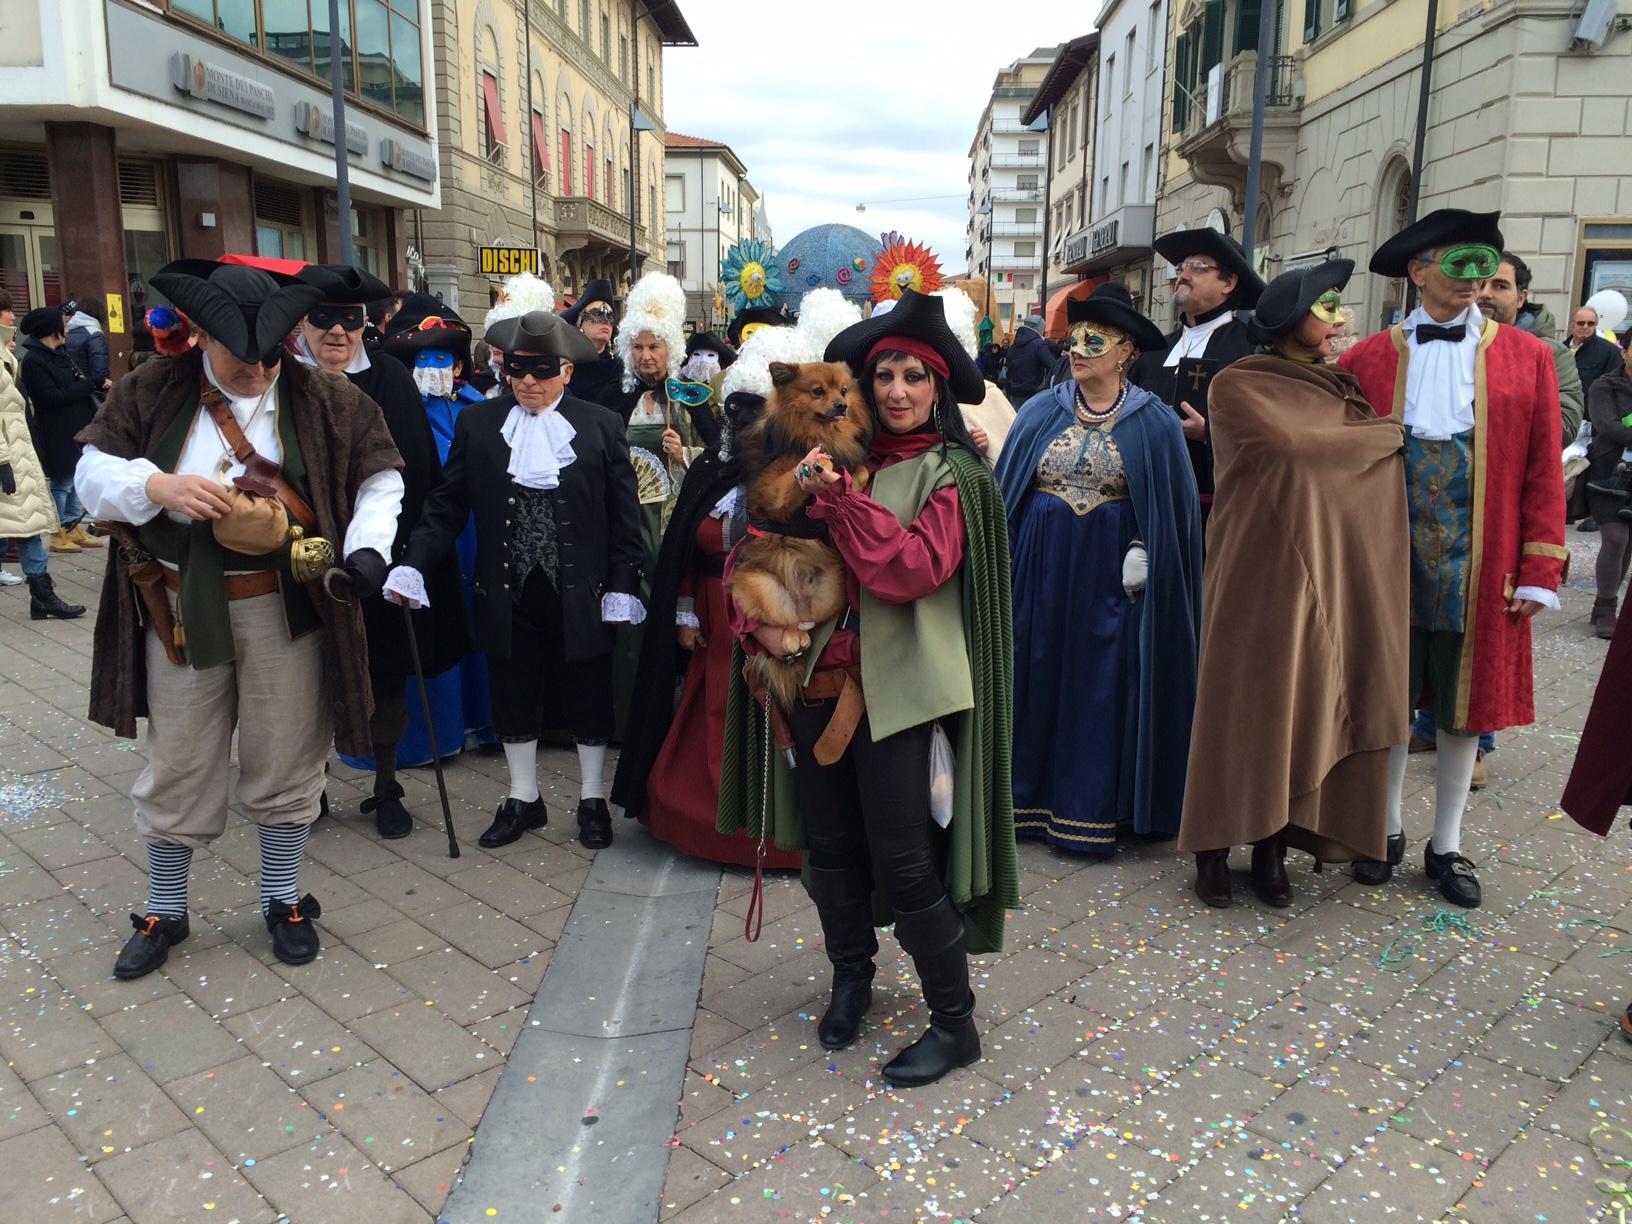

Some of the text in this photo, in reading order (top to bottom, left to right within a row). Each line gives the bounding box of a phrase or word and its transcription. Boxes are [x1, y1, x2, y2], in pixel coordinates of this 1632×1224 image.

[207, 66, 233, 88] MONTE
[235, 78, 248, 93] DEI
[207, 81, 216, 95] DI
[217, 86, 239, 104] SIENA
[482, 248, 537, 274] DISCHI
